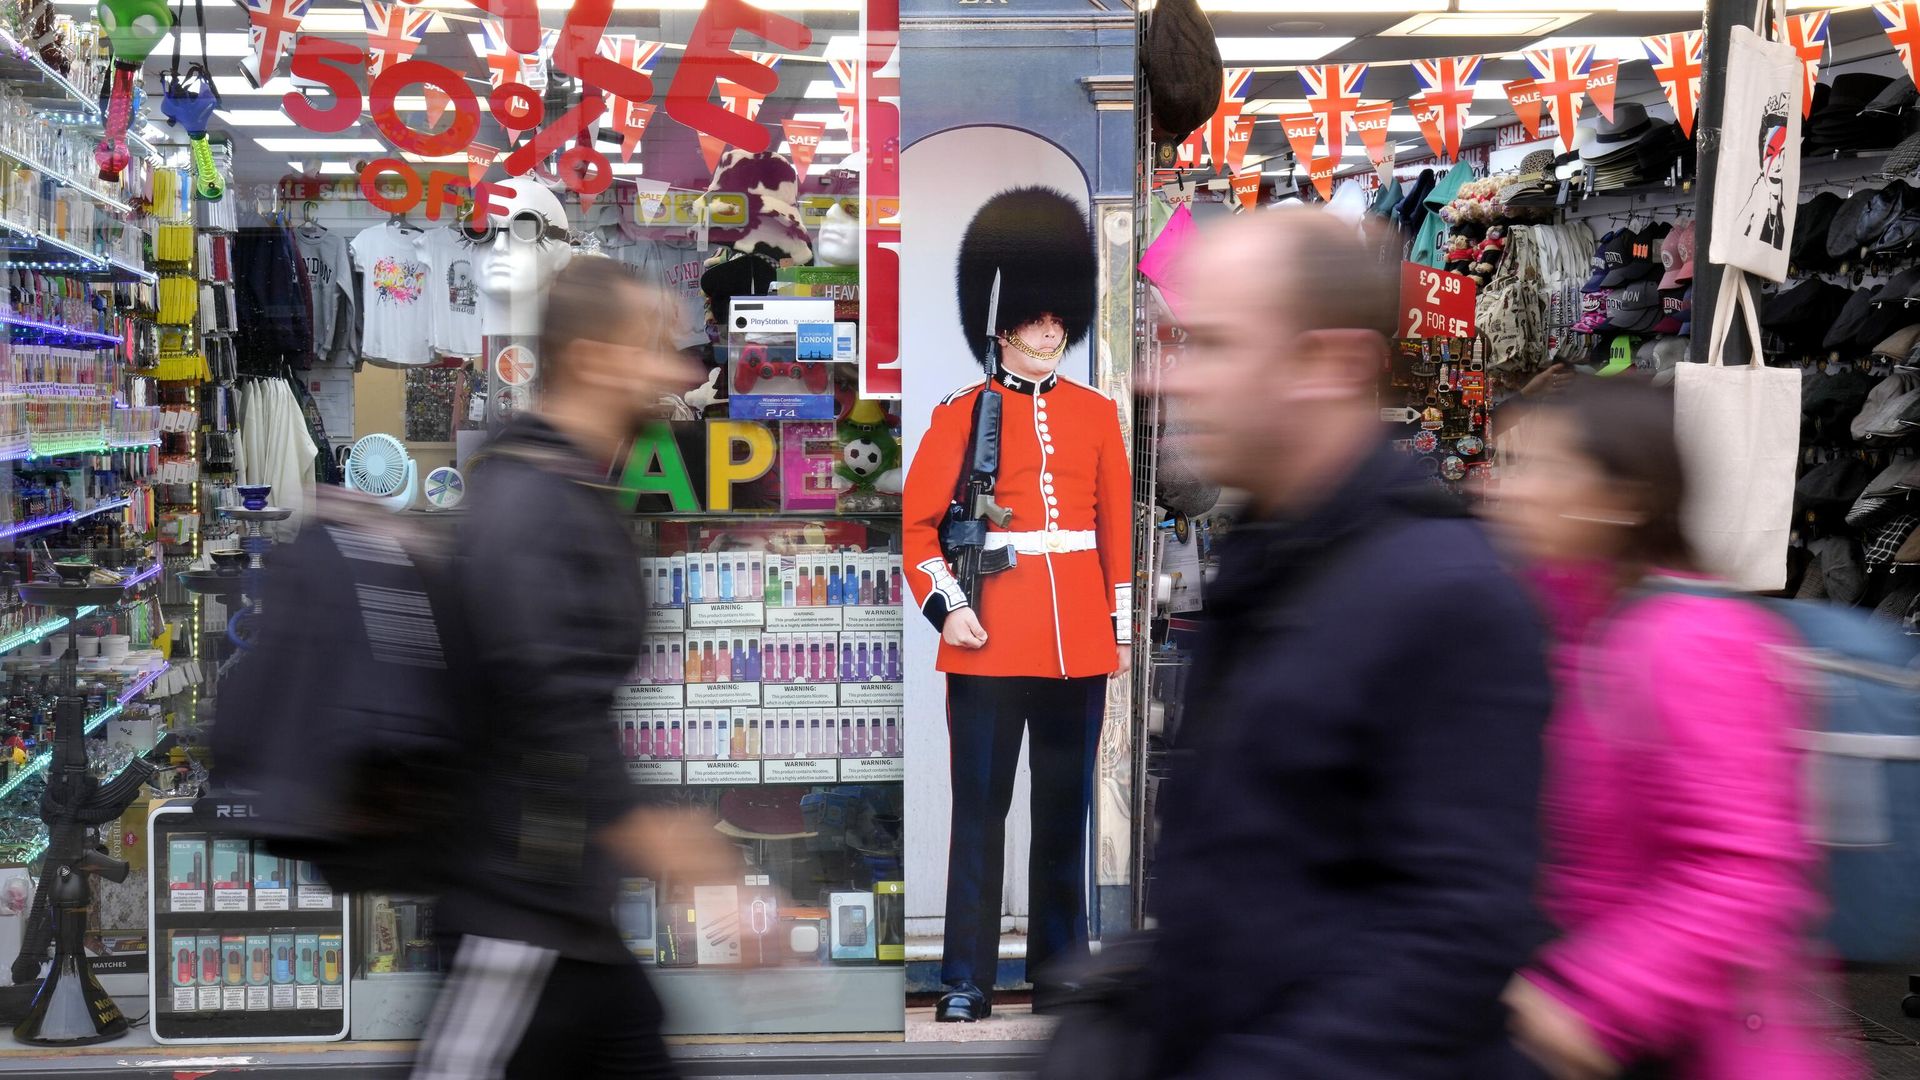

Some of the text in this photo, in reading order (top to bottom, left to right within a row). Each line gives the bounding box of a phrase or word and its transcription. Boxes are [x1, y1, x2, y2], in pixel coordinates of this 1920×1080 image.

[1586, 74, 1615, 90] SALE
[1511, 91, 1541, 106] SALE
[281, 35, 613, 195] 50%
[1416, 110, 1433, 123] SA
[624, 116, 646, 129] ALE
[1357, 118, 1387, 131] SALE
[1229, 131, 1248, 142] ALE
[1287, 126, 1317, 139] SALE
[1500, 124, 1527, 147] SALE
[788, 134, 819, 146] SALE
[469, 155, 492, 168] SALE
[1311, 170, 1332, 181] SALE
[359, 157, 517, 232] OFF
[1236, 184, 1258, 195] SALE
[640, 191, 662, 202] SALE
[303, 256, 333, 284] NDON
[1419, 269, 1461, 306] £2.99
[751, 318, 788, 327] PlayStation
[1407, 307, 1423, 339] 2
[1427, 311, 1446, 331] FOR
[799, 336, 833, 344] LONDON
[766, 409, 796, 417] PS4
[618, 418, 840, 513] APE
[216, 804, 262, 818] REL
[92, 961, 127, 969] MATCHES
